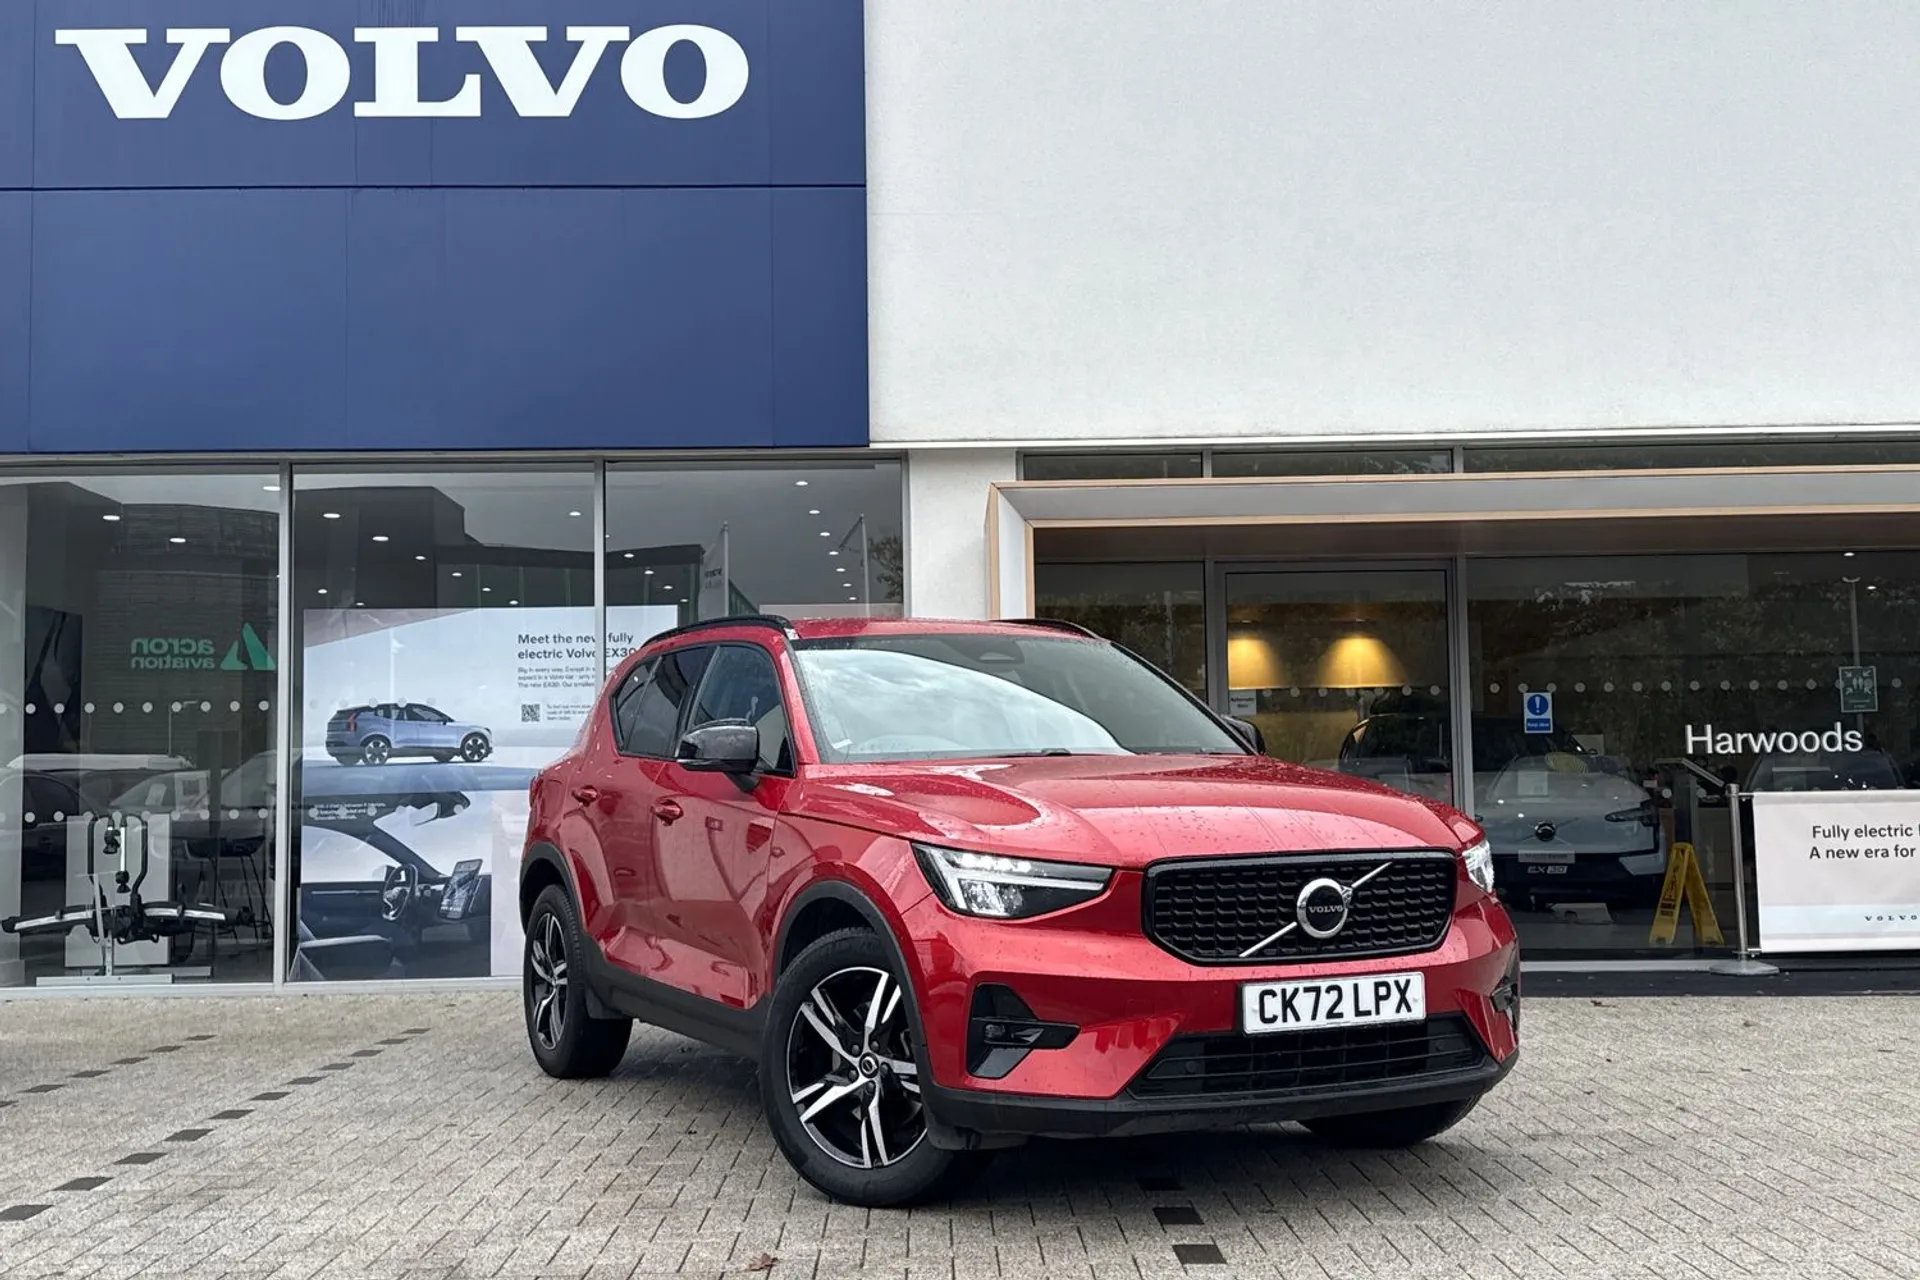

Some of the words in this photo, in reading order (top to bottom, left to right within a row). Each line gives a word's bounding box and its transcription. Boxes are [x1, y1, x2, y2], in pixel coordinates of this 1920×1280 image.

[55, 25, 749, 120] VOLVO
[518, 634, 549, 644] Meet
[553, 633, 573, 644] the
[608, 632, 634, 645] fully
[518, 648, 563, 659] electric
[1685, 721, 1864, 755] Harwoods
[1812, 825, 1850, 841] Fully
[1854, 824, 1913, 838] electric
[1809, 846, 1821, 859] A
[1826, 848, 1859, 859] new
[1864, 848, 1889, 858] era
[1894, 844, 1916, 858] for
[1308, 905, 1343, 913] VOLVO
[1865, 914, 1918, 922] VOLVO
[1258, 984, 1344, 1024] CK72
[1353, 979, 1413, 1017] LPX
